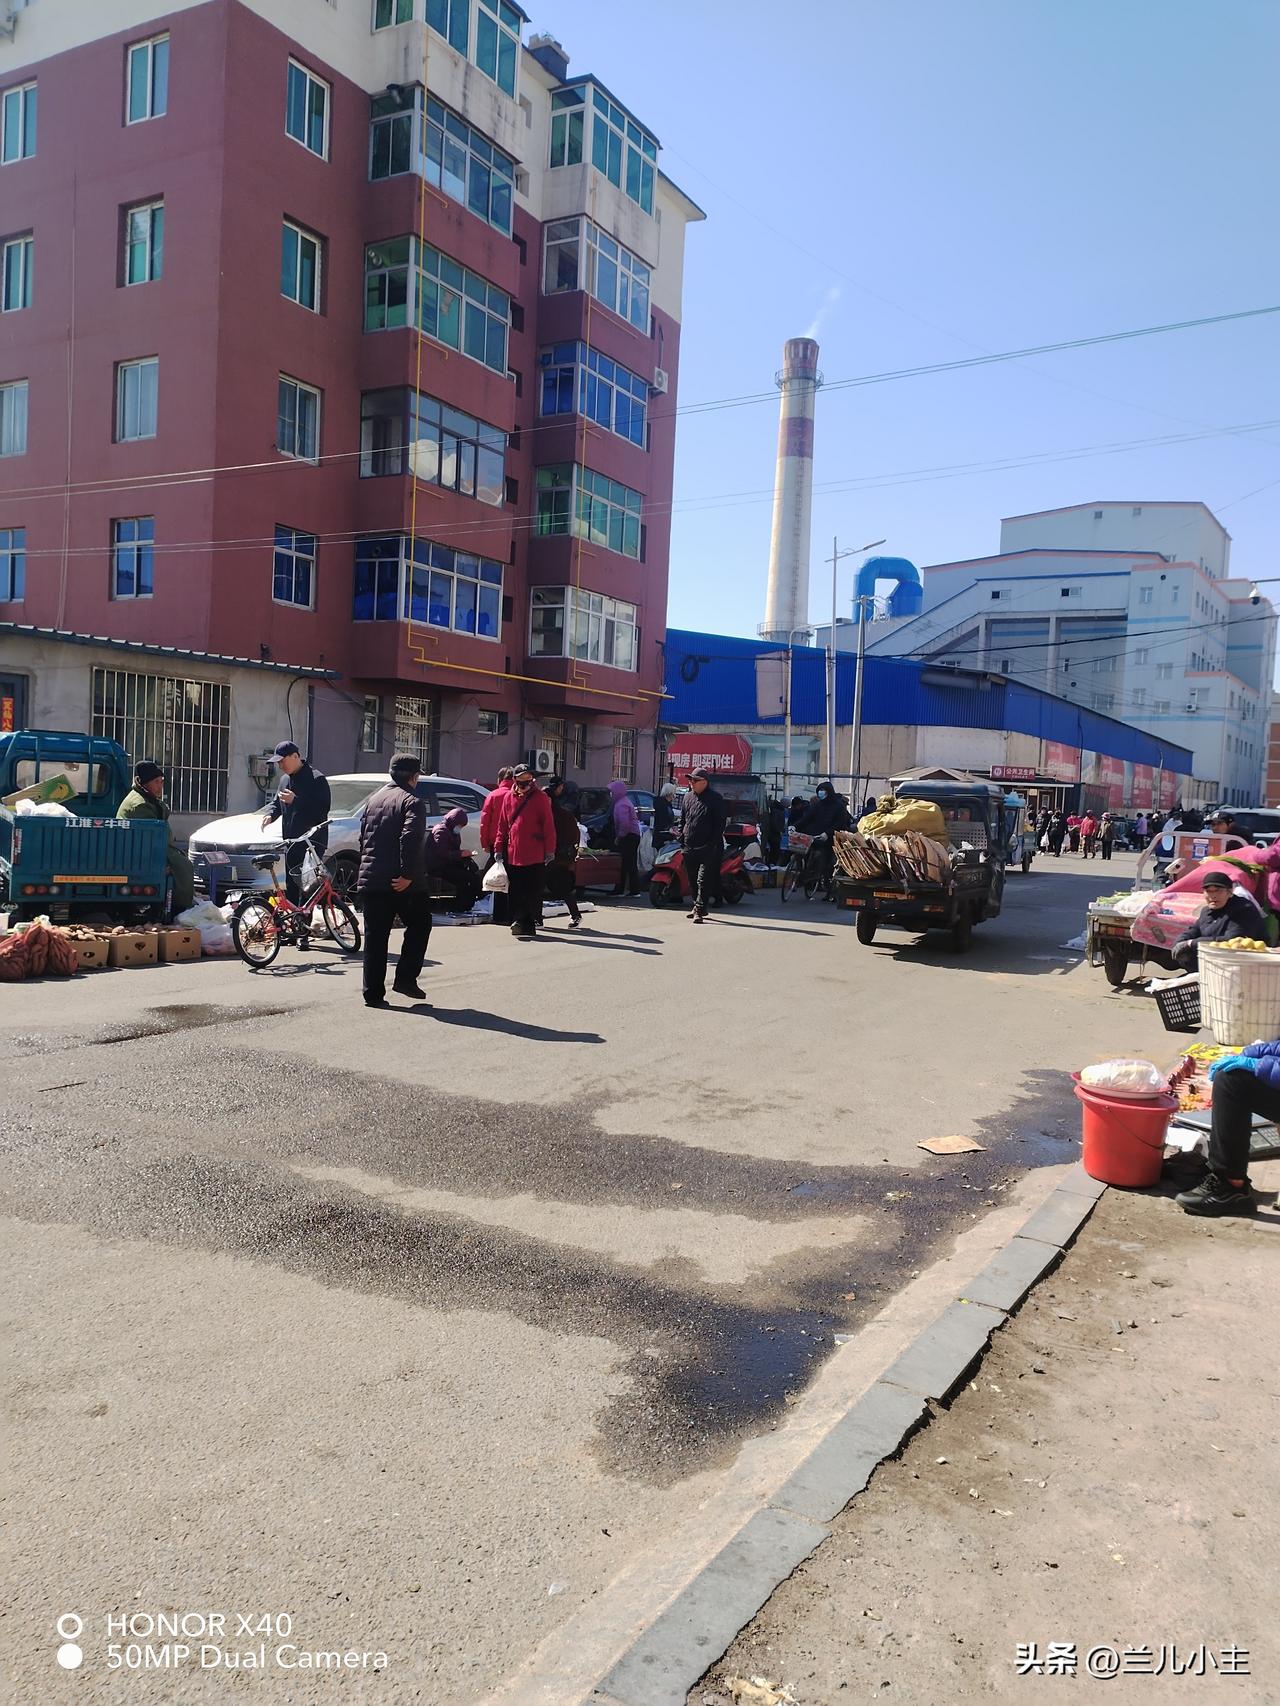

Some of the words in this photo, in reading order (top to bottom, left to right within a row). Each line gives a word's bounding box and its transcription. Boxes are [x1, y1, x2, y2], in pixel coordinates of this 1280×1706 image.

[692, 753, 734, 769] 即买即住!
[1006, 767, 1035, 776] 公共卫生间
[65, 817, 92, 828] 江淮
